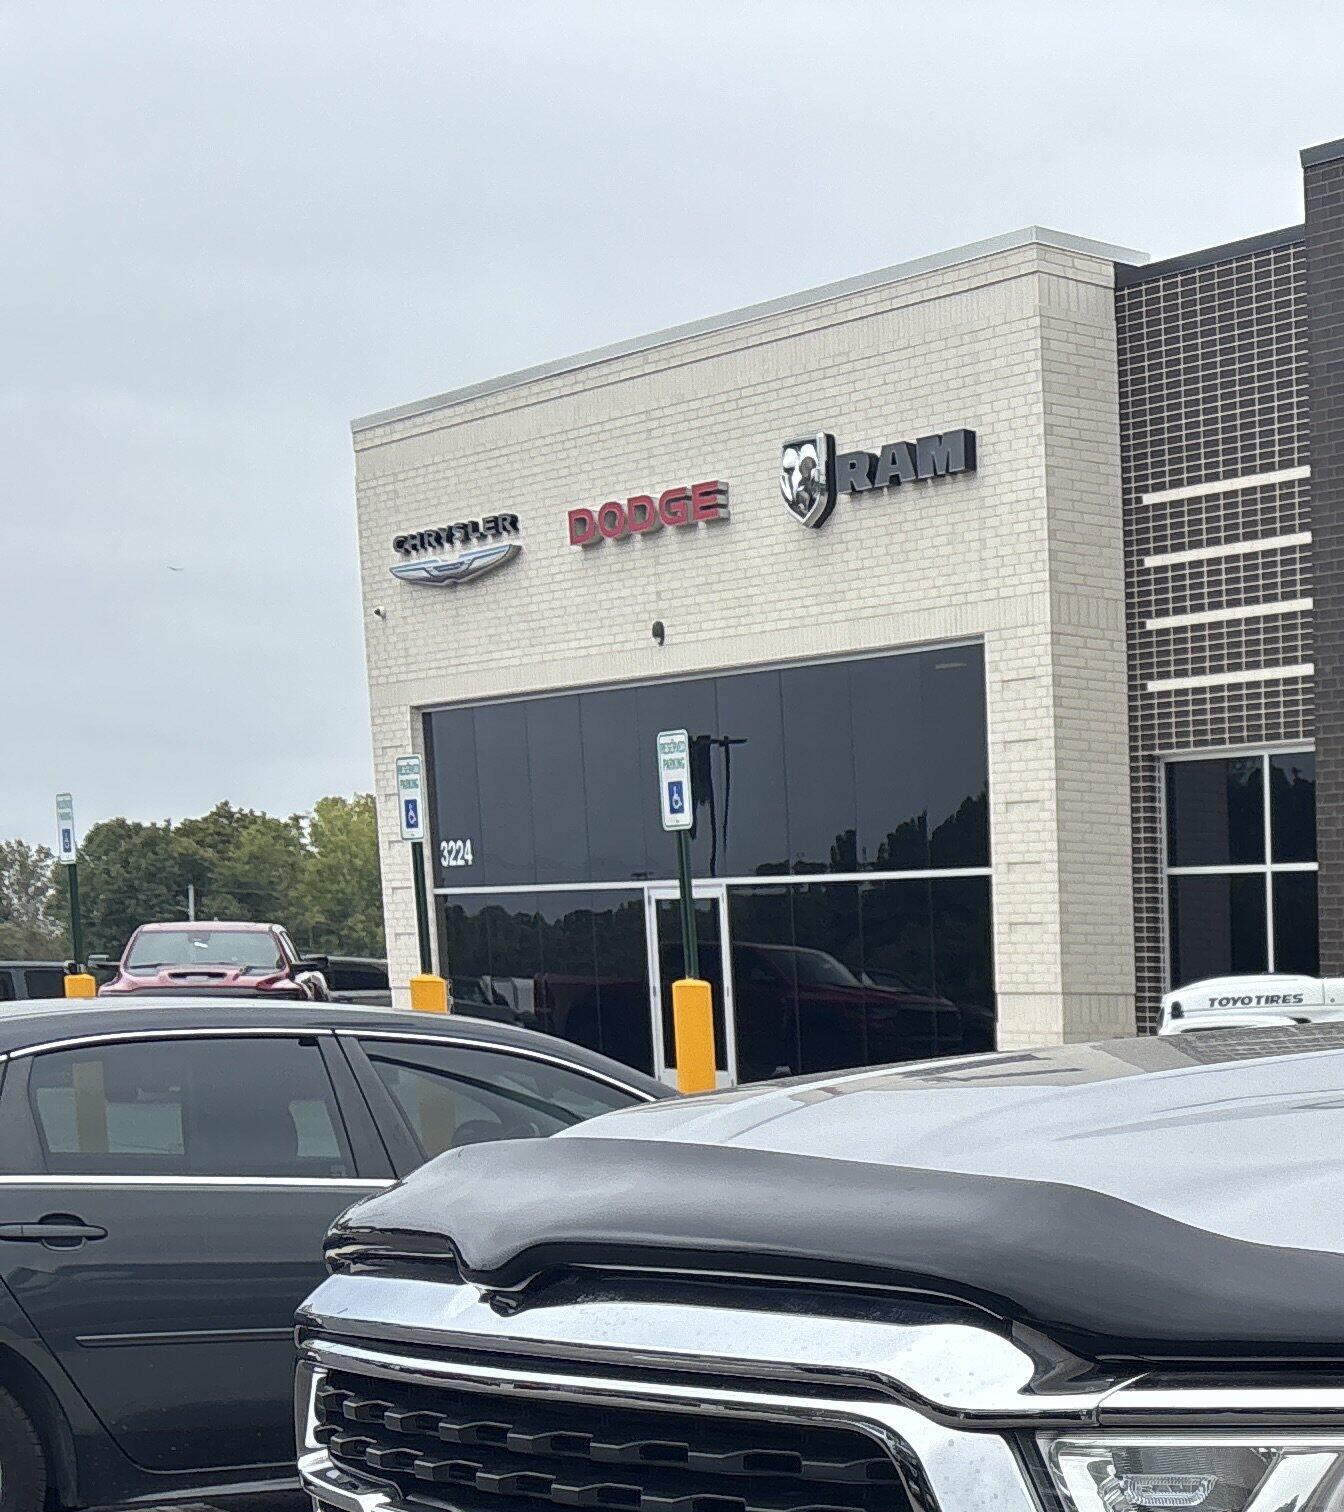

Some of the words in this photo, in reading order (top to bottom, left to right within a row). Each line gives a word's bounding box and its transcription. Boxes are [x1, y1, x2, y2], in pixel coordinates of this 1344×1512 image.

[836, 429, 977, 493] RAM
[393, 513, 520, 555] CHRYSLER
[567, 479, 729, 548] DODGE
[440, 839, 473, 867] 3224
[1208, 996, 1253, 1008] TOYO
[1254, 993, 1304, 1006] TIRES
